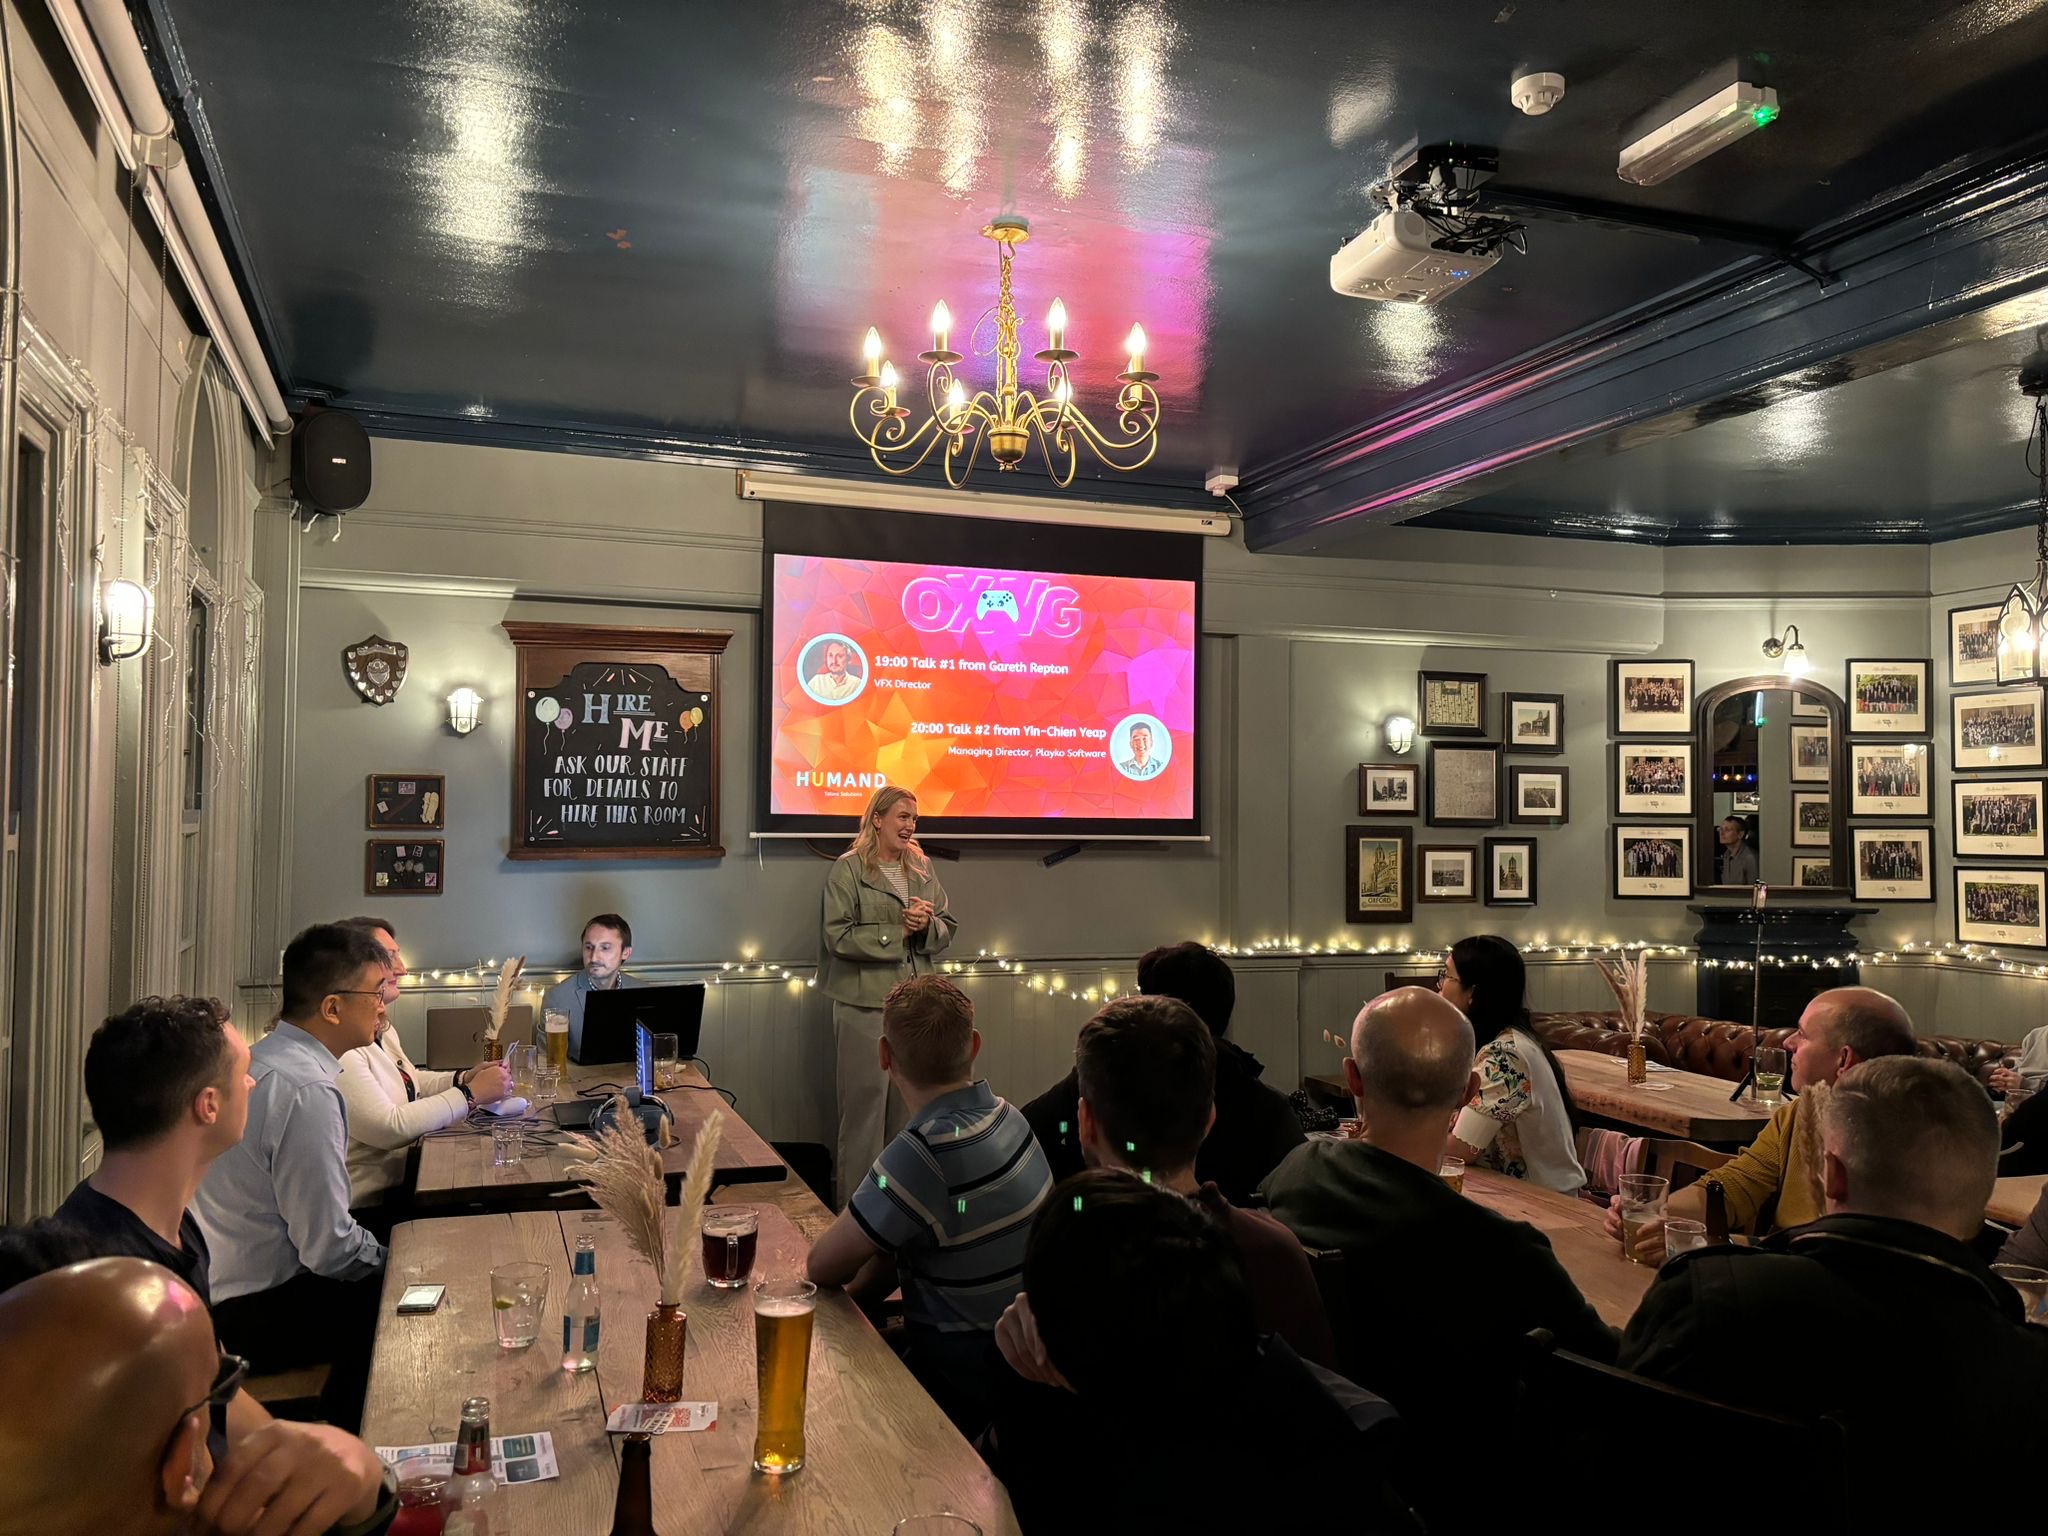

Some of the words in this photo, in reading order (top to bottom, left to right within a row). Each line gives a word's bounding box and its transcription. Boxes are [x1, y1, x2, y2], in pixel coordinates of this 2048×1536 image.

[874, 655, 908, 668] 19:00
[911, 657, 937, 669] Talk
[939, 658, 955, 670] #1
[958, 659, 986, 671] from
[989, 660, 1027, 673] Gareth
[1030, 662, 1069, 676] Repton
[874, 678, 893, 688] VFX
[895, 679, 931, 689] Director
[581, 693, 652, 724] HIRE
[911, 722, 943, 734] 20:00
[946, 723, 971, 735] Talk
[975, 724, 990, 735] #2
[993, 724, 1020, 736] from
[1023, 725, 1076, 738] Yin-Chien
[1079, 727, 1106, 740] Yeap
[948, 747, 993, 757] Managing
[995, 747, 1032, 758] Director,
[1036, 748, 1065, 759] Playko
[1067, 748, 1106, 758] Software
[555, 756, 587, 775] ASK
[594, 755, 635, 776] OUR
[640, 756, 689, 777] STAFF
[543, 778, 577, 800] FOR
[586, 778, 651, 799] DETAILS
[659, 780, 679, 801] TO
[796, 770, 887, 788] HUMAND
[561, 804, 600, 828] HIRE
[604, 804, 638, 824] THIS
[643, 805, 687, 826] ROOM
